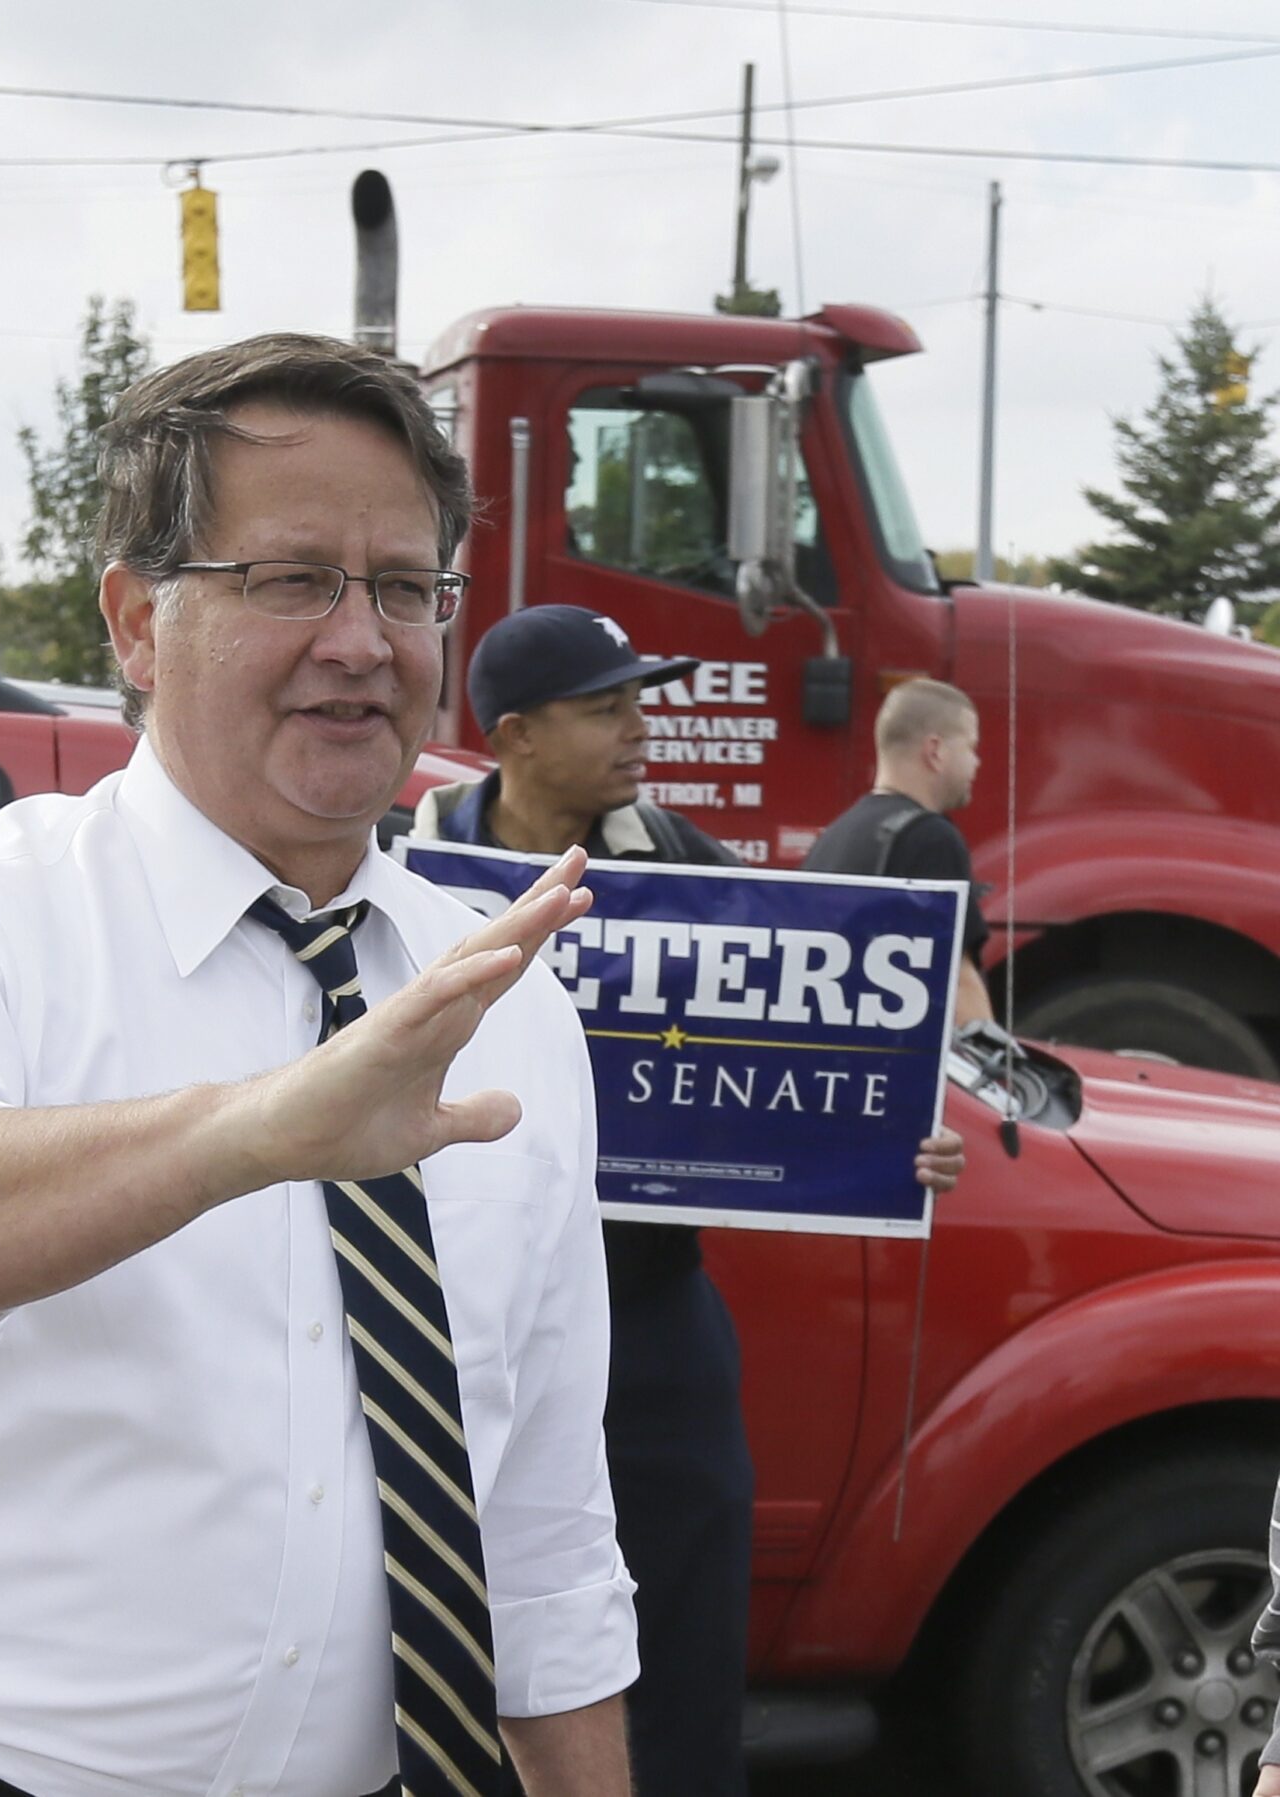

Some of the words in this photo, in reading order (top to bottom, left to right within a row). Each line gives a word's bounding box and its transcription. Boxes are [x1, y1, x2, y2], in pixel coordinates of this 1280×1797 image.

[642, 714, 777, 740] NTAINER
[642, 739, 764, 765] ERVICES
[733, 783, 762, 806] MI
[435, 884, 933, 1030] ETERS
[627, 1060, 888, 1117] SENATE
